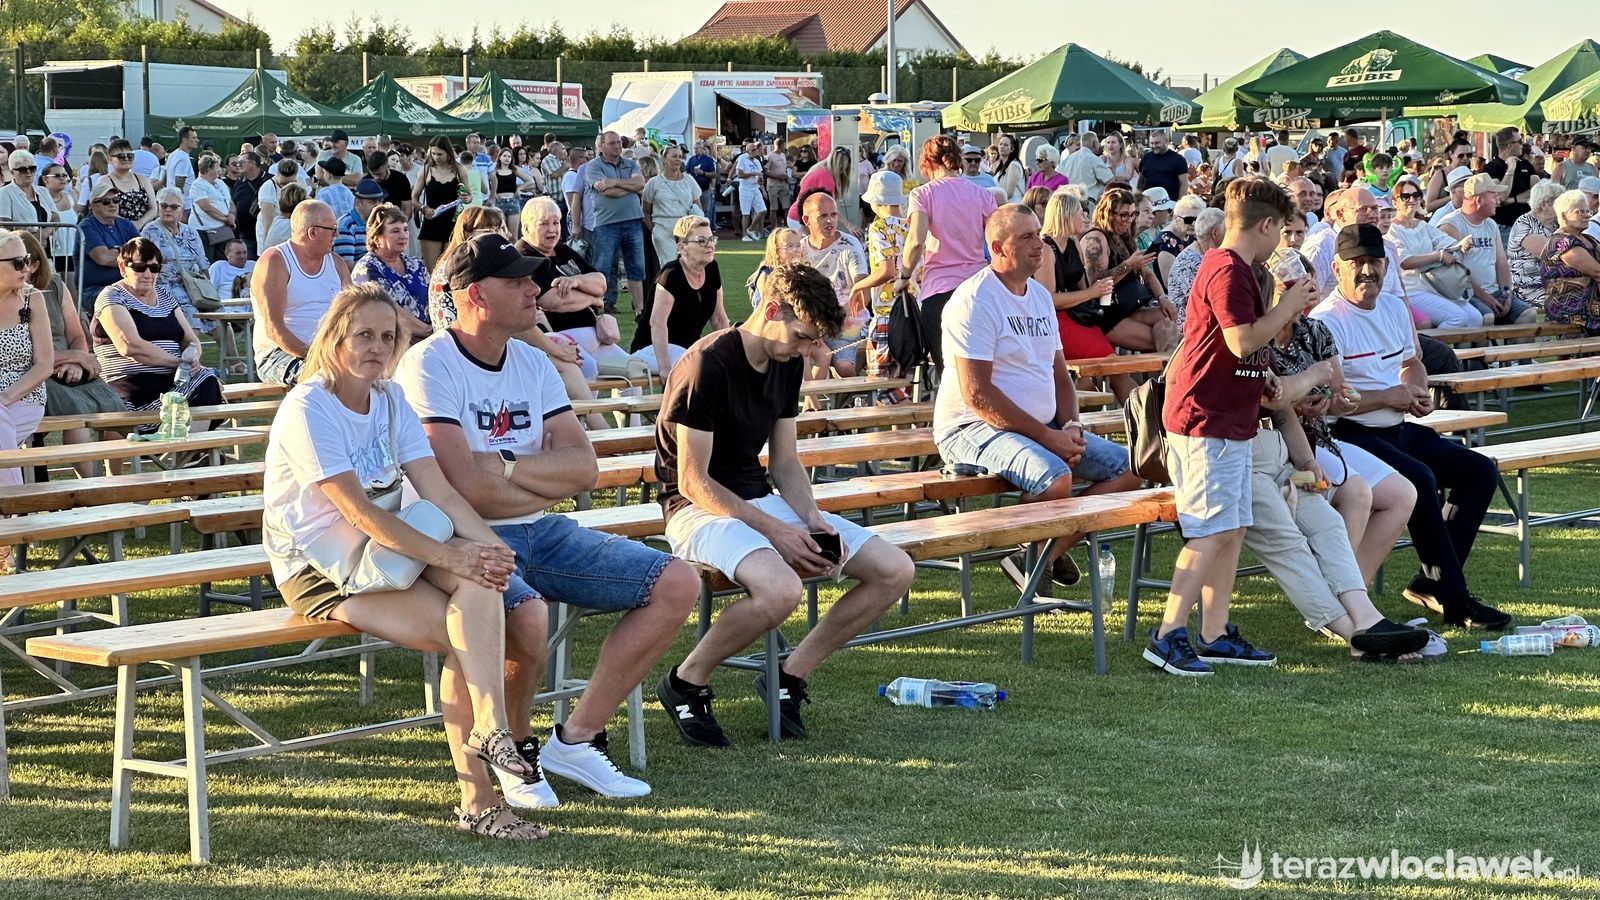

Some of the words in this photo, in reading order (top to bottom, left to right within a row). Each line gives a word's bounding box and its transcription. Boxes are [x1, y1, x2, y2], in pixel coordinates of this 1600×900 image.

[700, 79, 715, 87] KEBAB
[1334, 71, 1393, 85] ZUBR
[984, 103, 1026, 122] ZUBR
[1162, 106, 1189, 121] ZUBR
[477, 410, 531, 431] DC
